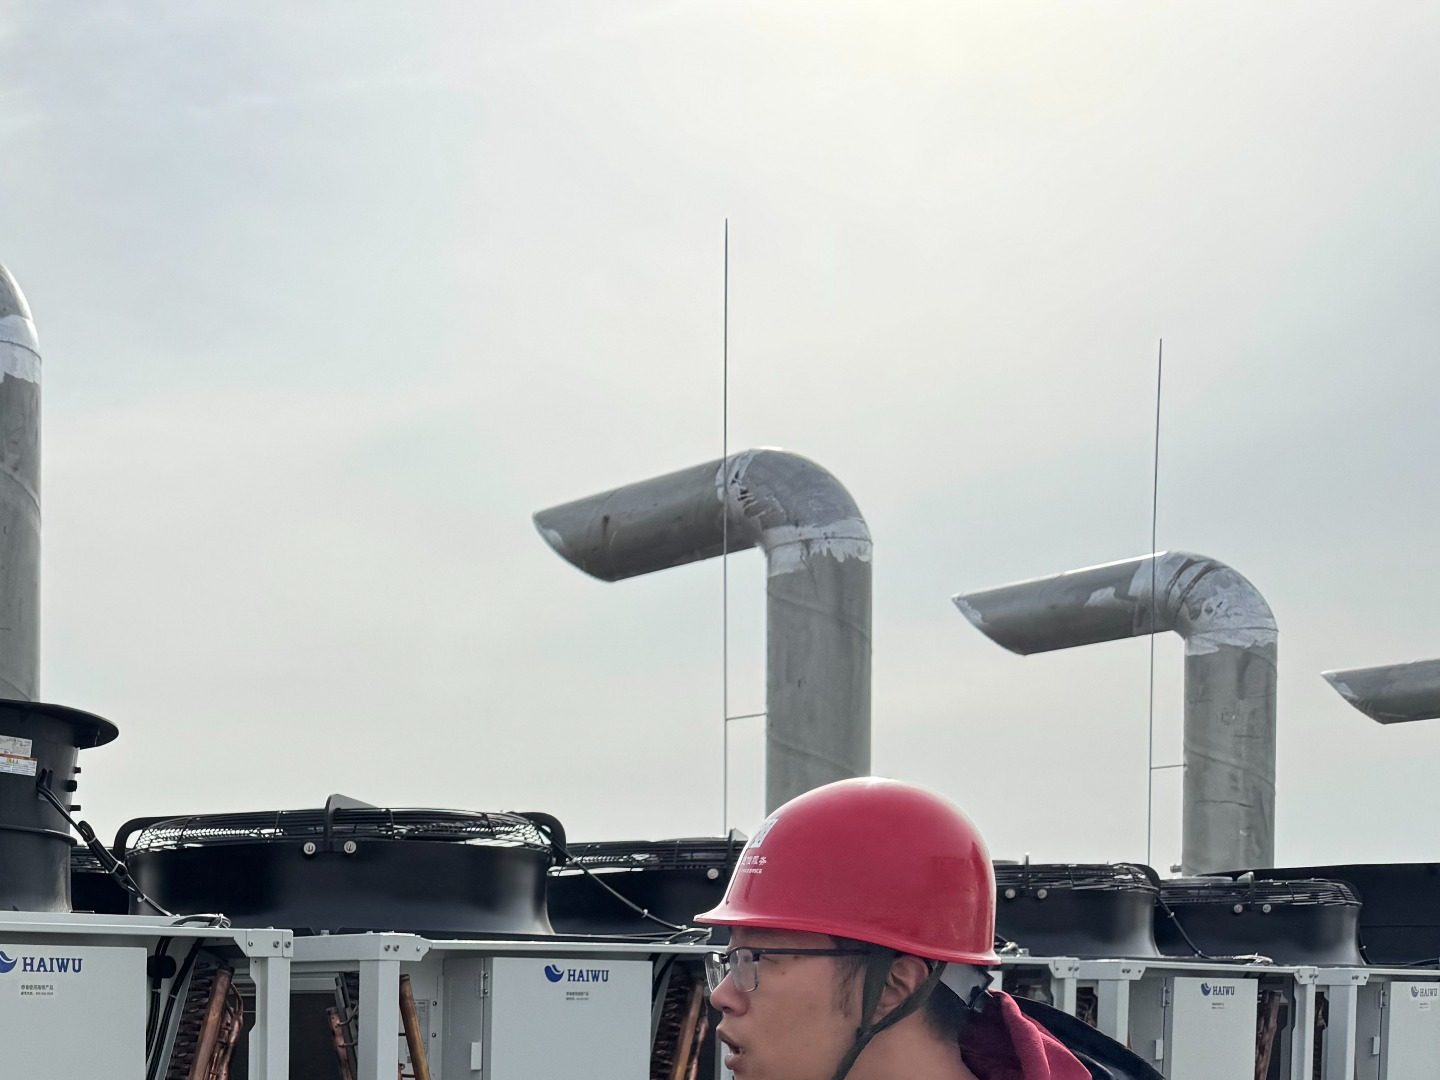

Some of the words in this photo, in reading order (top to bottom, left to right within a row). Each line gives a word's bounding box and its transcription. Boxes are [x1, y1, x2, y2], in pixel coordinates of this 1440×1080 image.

[21, 956, 84, 973] HAIWU
[567, 968, 610, 983] HAIWU
[1212, 985, 1236, 996] HAIWU
